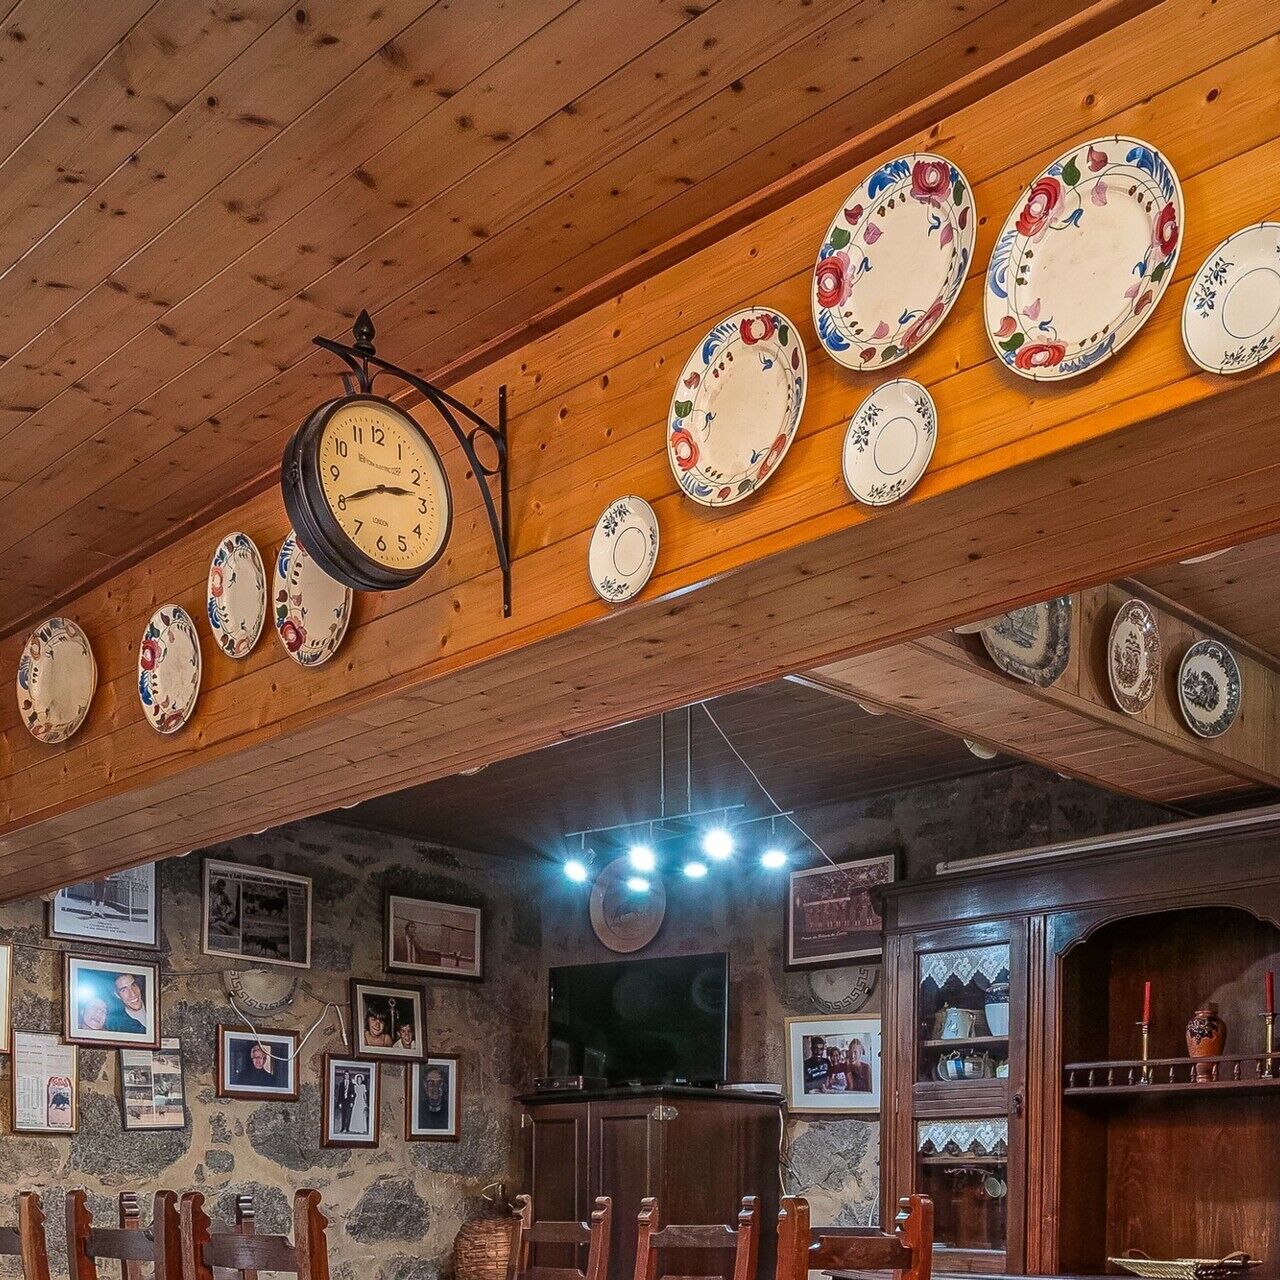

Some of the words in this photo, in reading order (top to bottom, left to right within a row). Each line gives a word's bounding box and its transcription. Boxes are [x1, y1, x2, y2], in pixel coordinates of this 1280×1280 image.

[353, 425, 362, 444] 11
[371, 426, 385, 446] 12
[335, 438, 348, 458] 10
[398, 443, 401, 460] 1
[330, 465, 340, 481] 9
[411, 469, 421, 486] 2
[337, 494, 347, 511] 8
[418, 497, 427, 514] 3
[354, 519, 363, 535] 7
[372, 517, 389, 528] LONDON
[412, 523, 422, 539] 4
[376, 535, 387, 552] 6
[398, 535, 407, 552] 5
